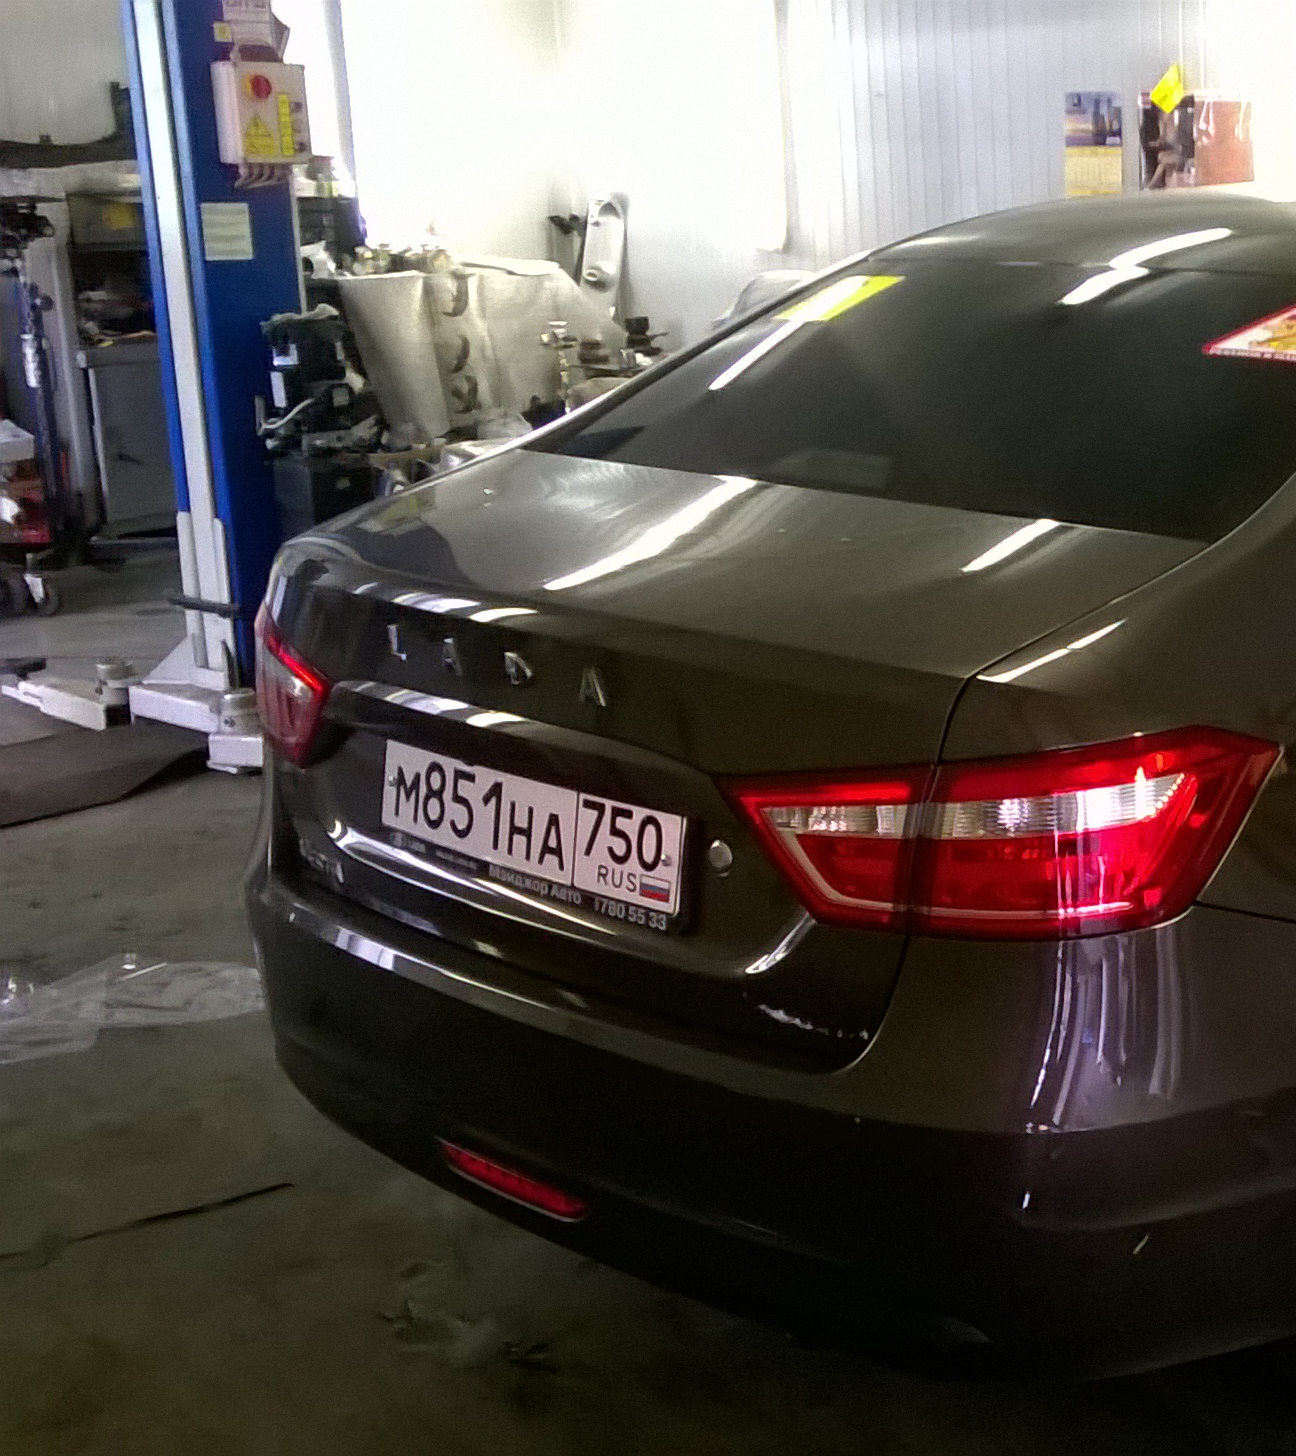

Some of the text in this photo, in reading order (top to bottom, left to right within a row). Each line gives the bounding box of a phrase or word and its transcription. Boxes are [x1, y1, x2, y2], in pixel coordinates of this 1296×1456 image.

[387, 624, 607, 707] LADA
[394, 761, 664, 872] М851НА 750
[596, 864, 637, 893] RUS
[628, 908, 646, 926] 55
[649, 912, 667, 931] 33
